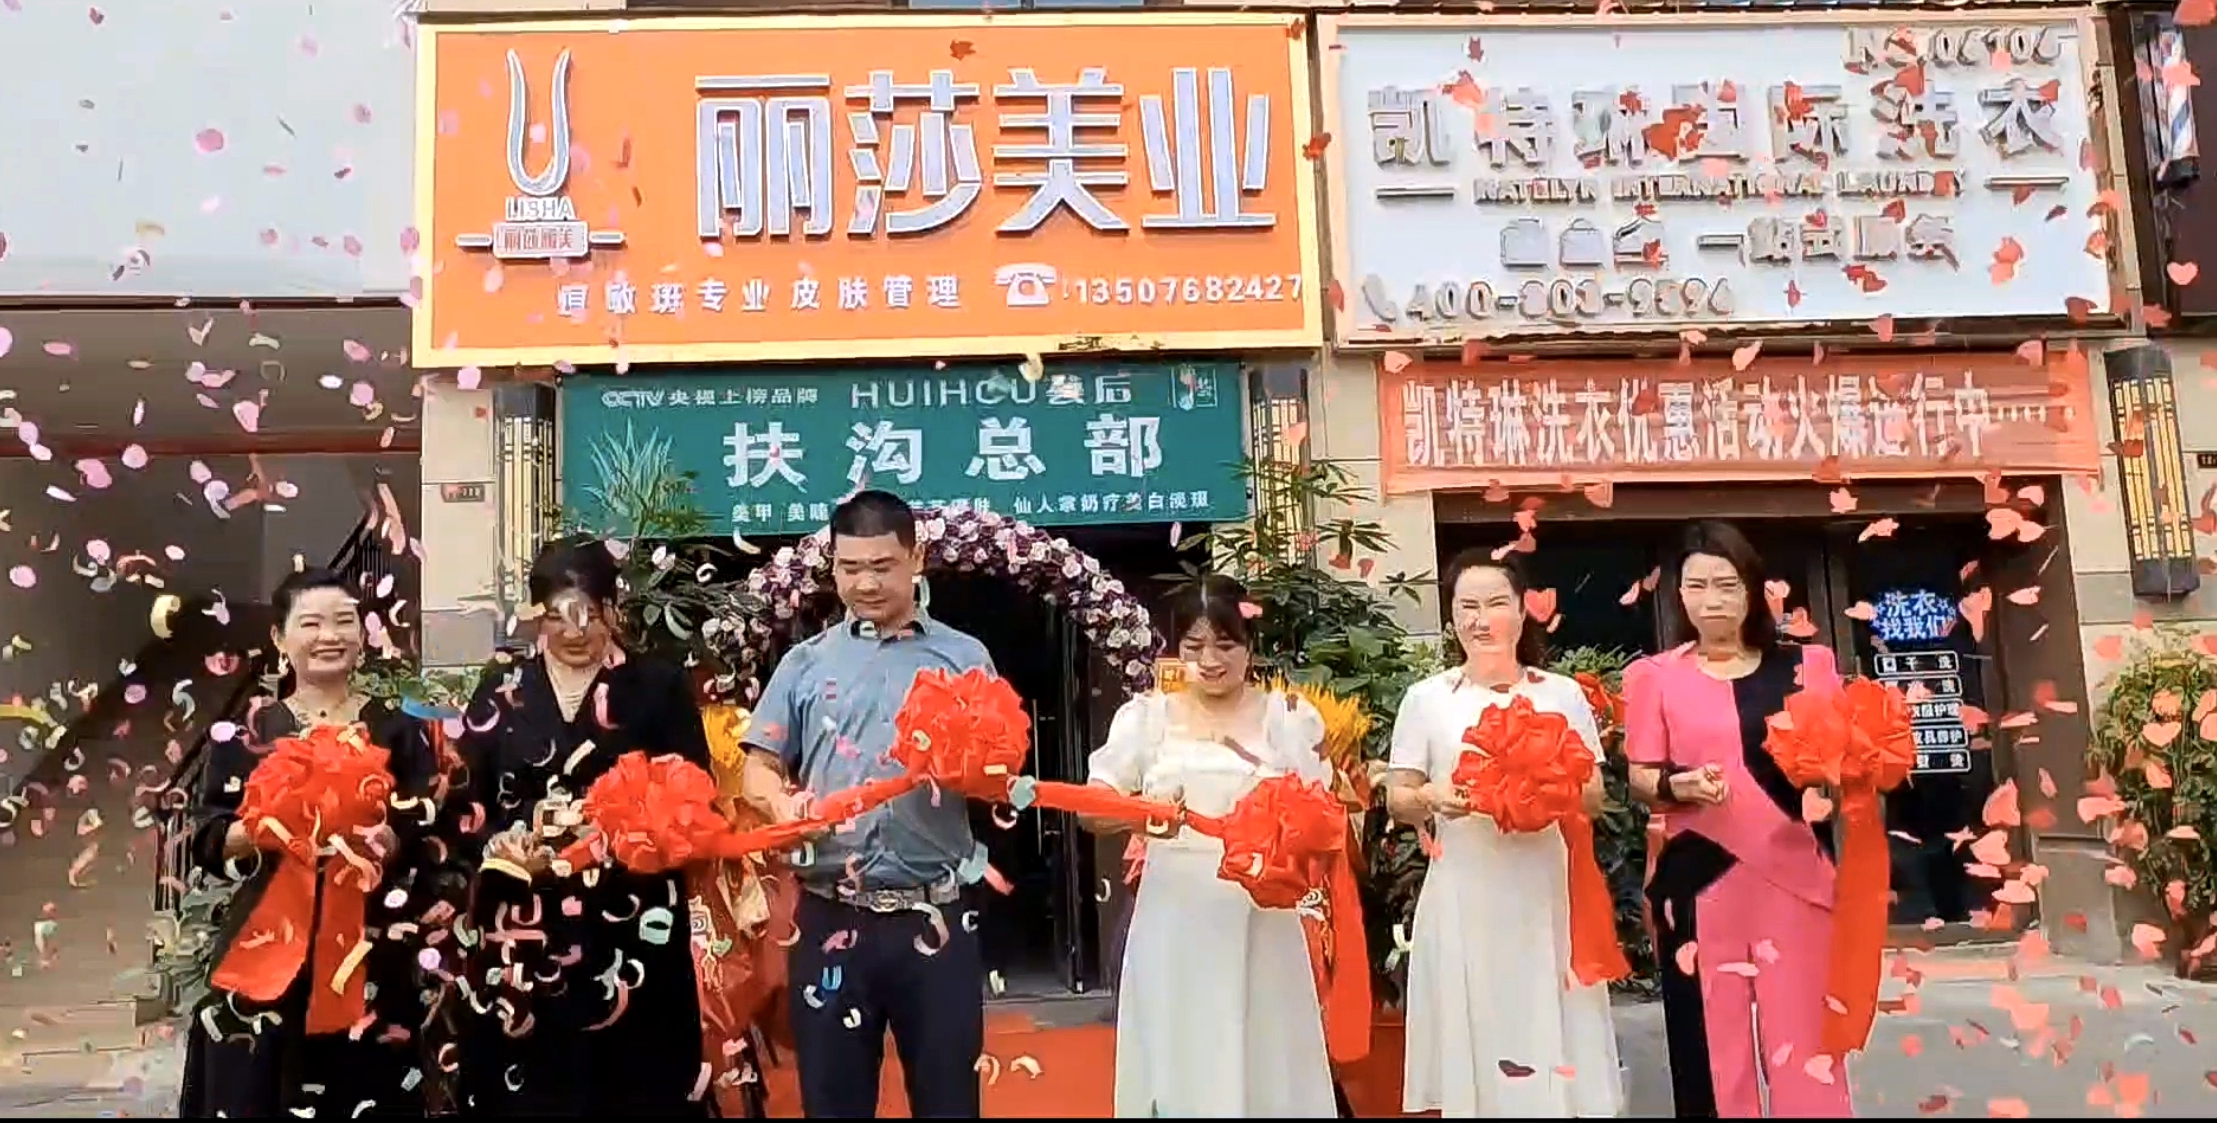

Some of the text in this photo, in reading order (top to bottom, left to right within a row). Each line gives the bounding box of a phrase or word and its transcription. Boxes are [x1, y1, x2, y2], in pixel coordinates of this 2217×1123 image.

[1368, 79, 2064, 168] 凯特琳国际洗衣
[695, 67, 1277, 238] 丽莎美业
[1836, 170, 1965, 198] LAUNDY
[506, 197, 576, 221] LISHA
[723, 414, 1164, 488] 扶沟总部
[1884, 589, 1938, 617] 洗衣
[1879, 615, 1946, 641] 找我们
